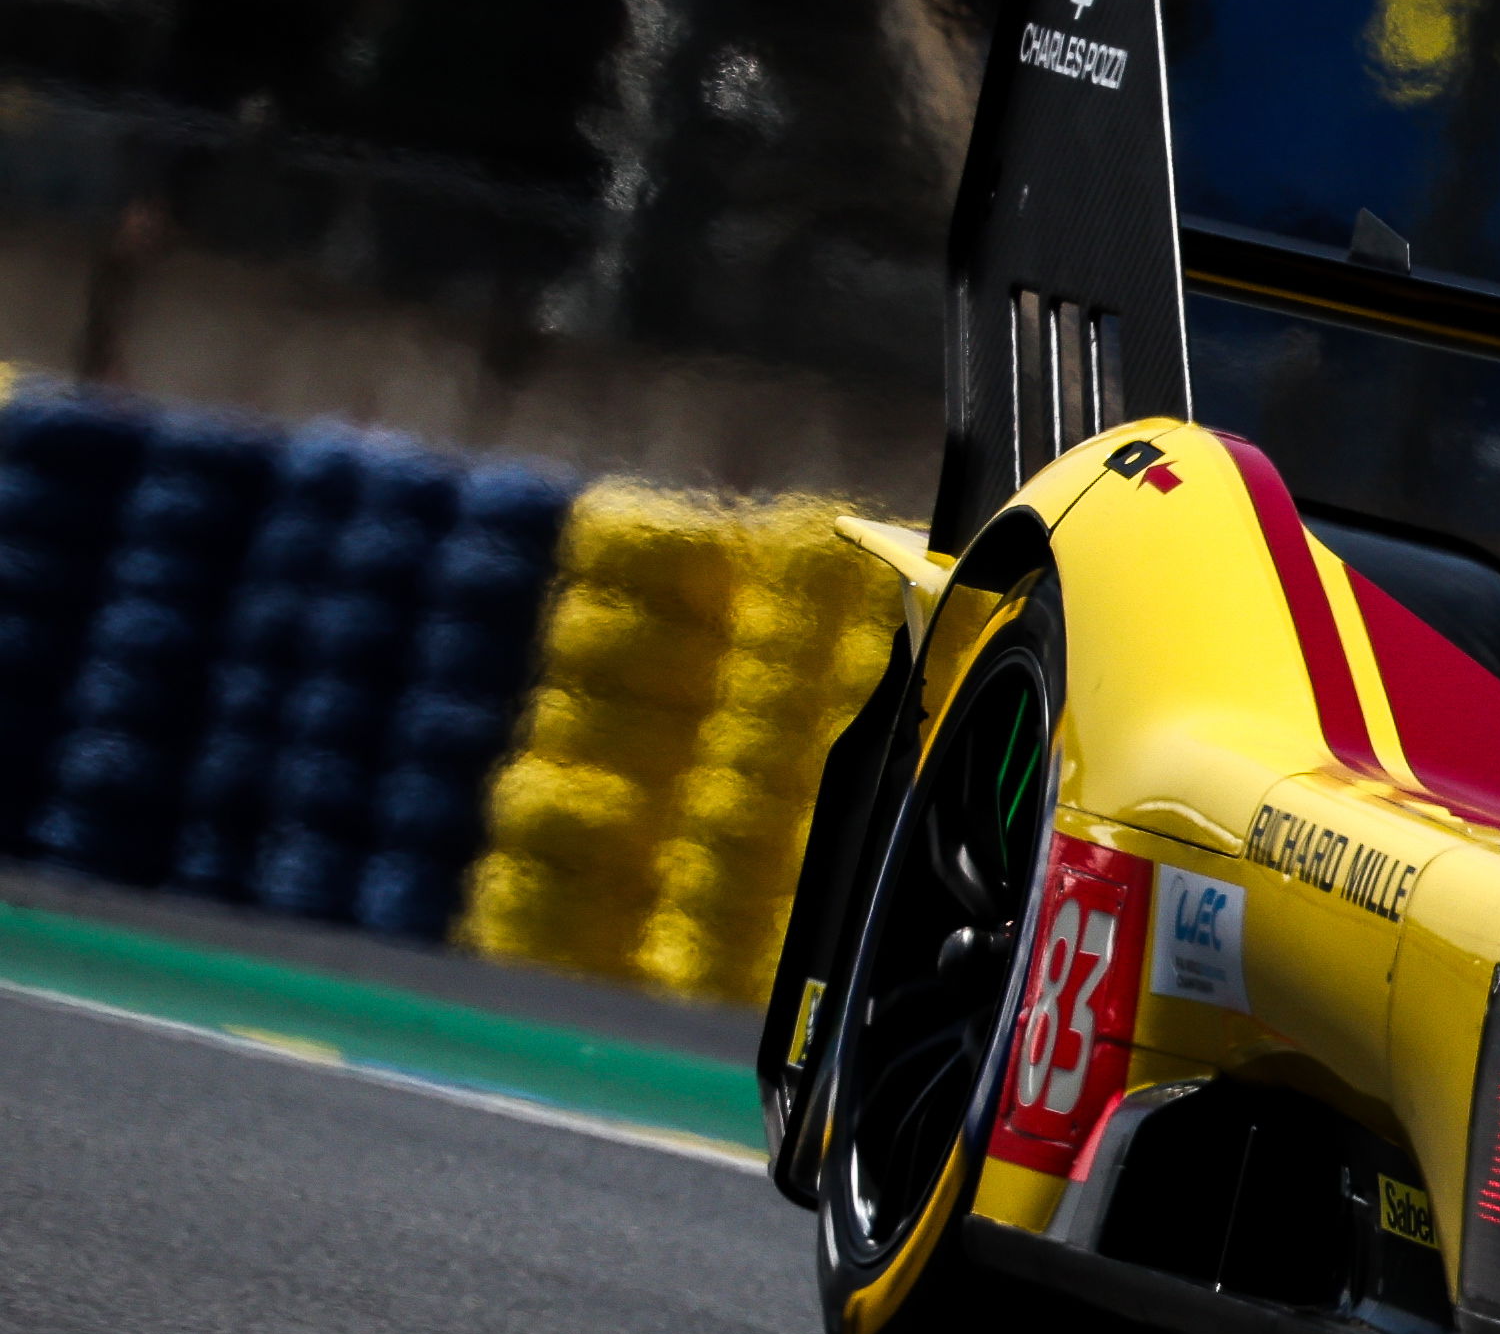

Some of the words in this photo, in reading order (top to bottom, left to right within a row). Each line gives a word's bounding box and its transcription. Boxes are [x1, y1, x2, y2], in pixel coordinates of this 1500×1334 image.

[1019, 22, 1086, 78] CHARLES
[1081, 41, 1128, 89] POZZI
[1246, 804, 1349, 894] RICHARD
[1340, 842, 1417, 923] MILLE
[1017, 897, 1117, 1115] 83
